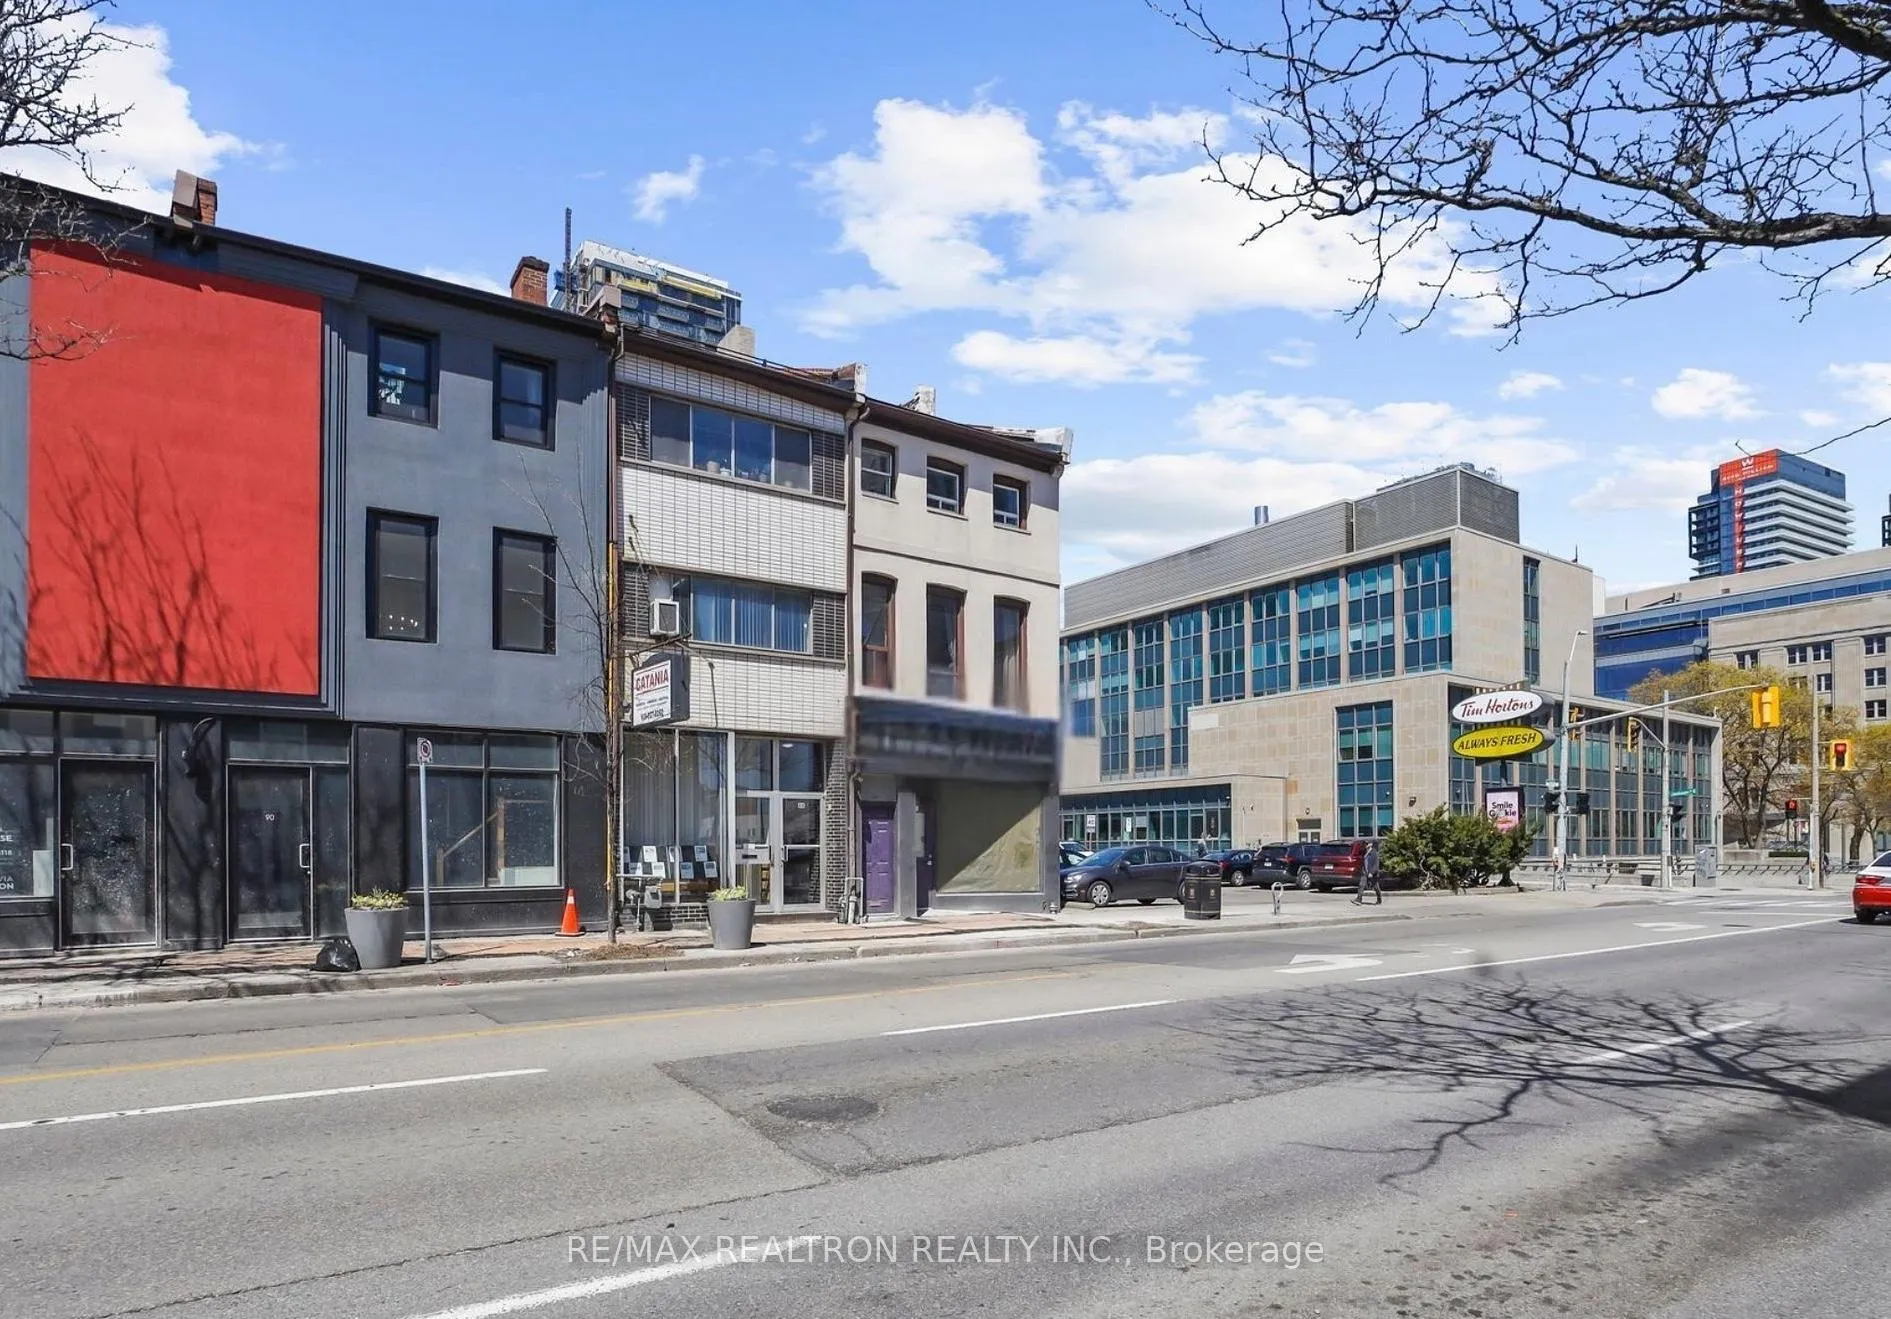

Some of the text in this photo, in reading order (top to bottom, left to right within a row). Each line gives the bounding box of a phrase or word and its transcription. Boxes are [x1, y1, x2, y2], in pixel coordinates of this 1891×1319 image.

[636, 669, 669, 692] CATANIA
[1461, 698, 1534, 718] Tim Hortons
[1458, 733, 1537, 750] ALWAYS FRESH
